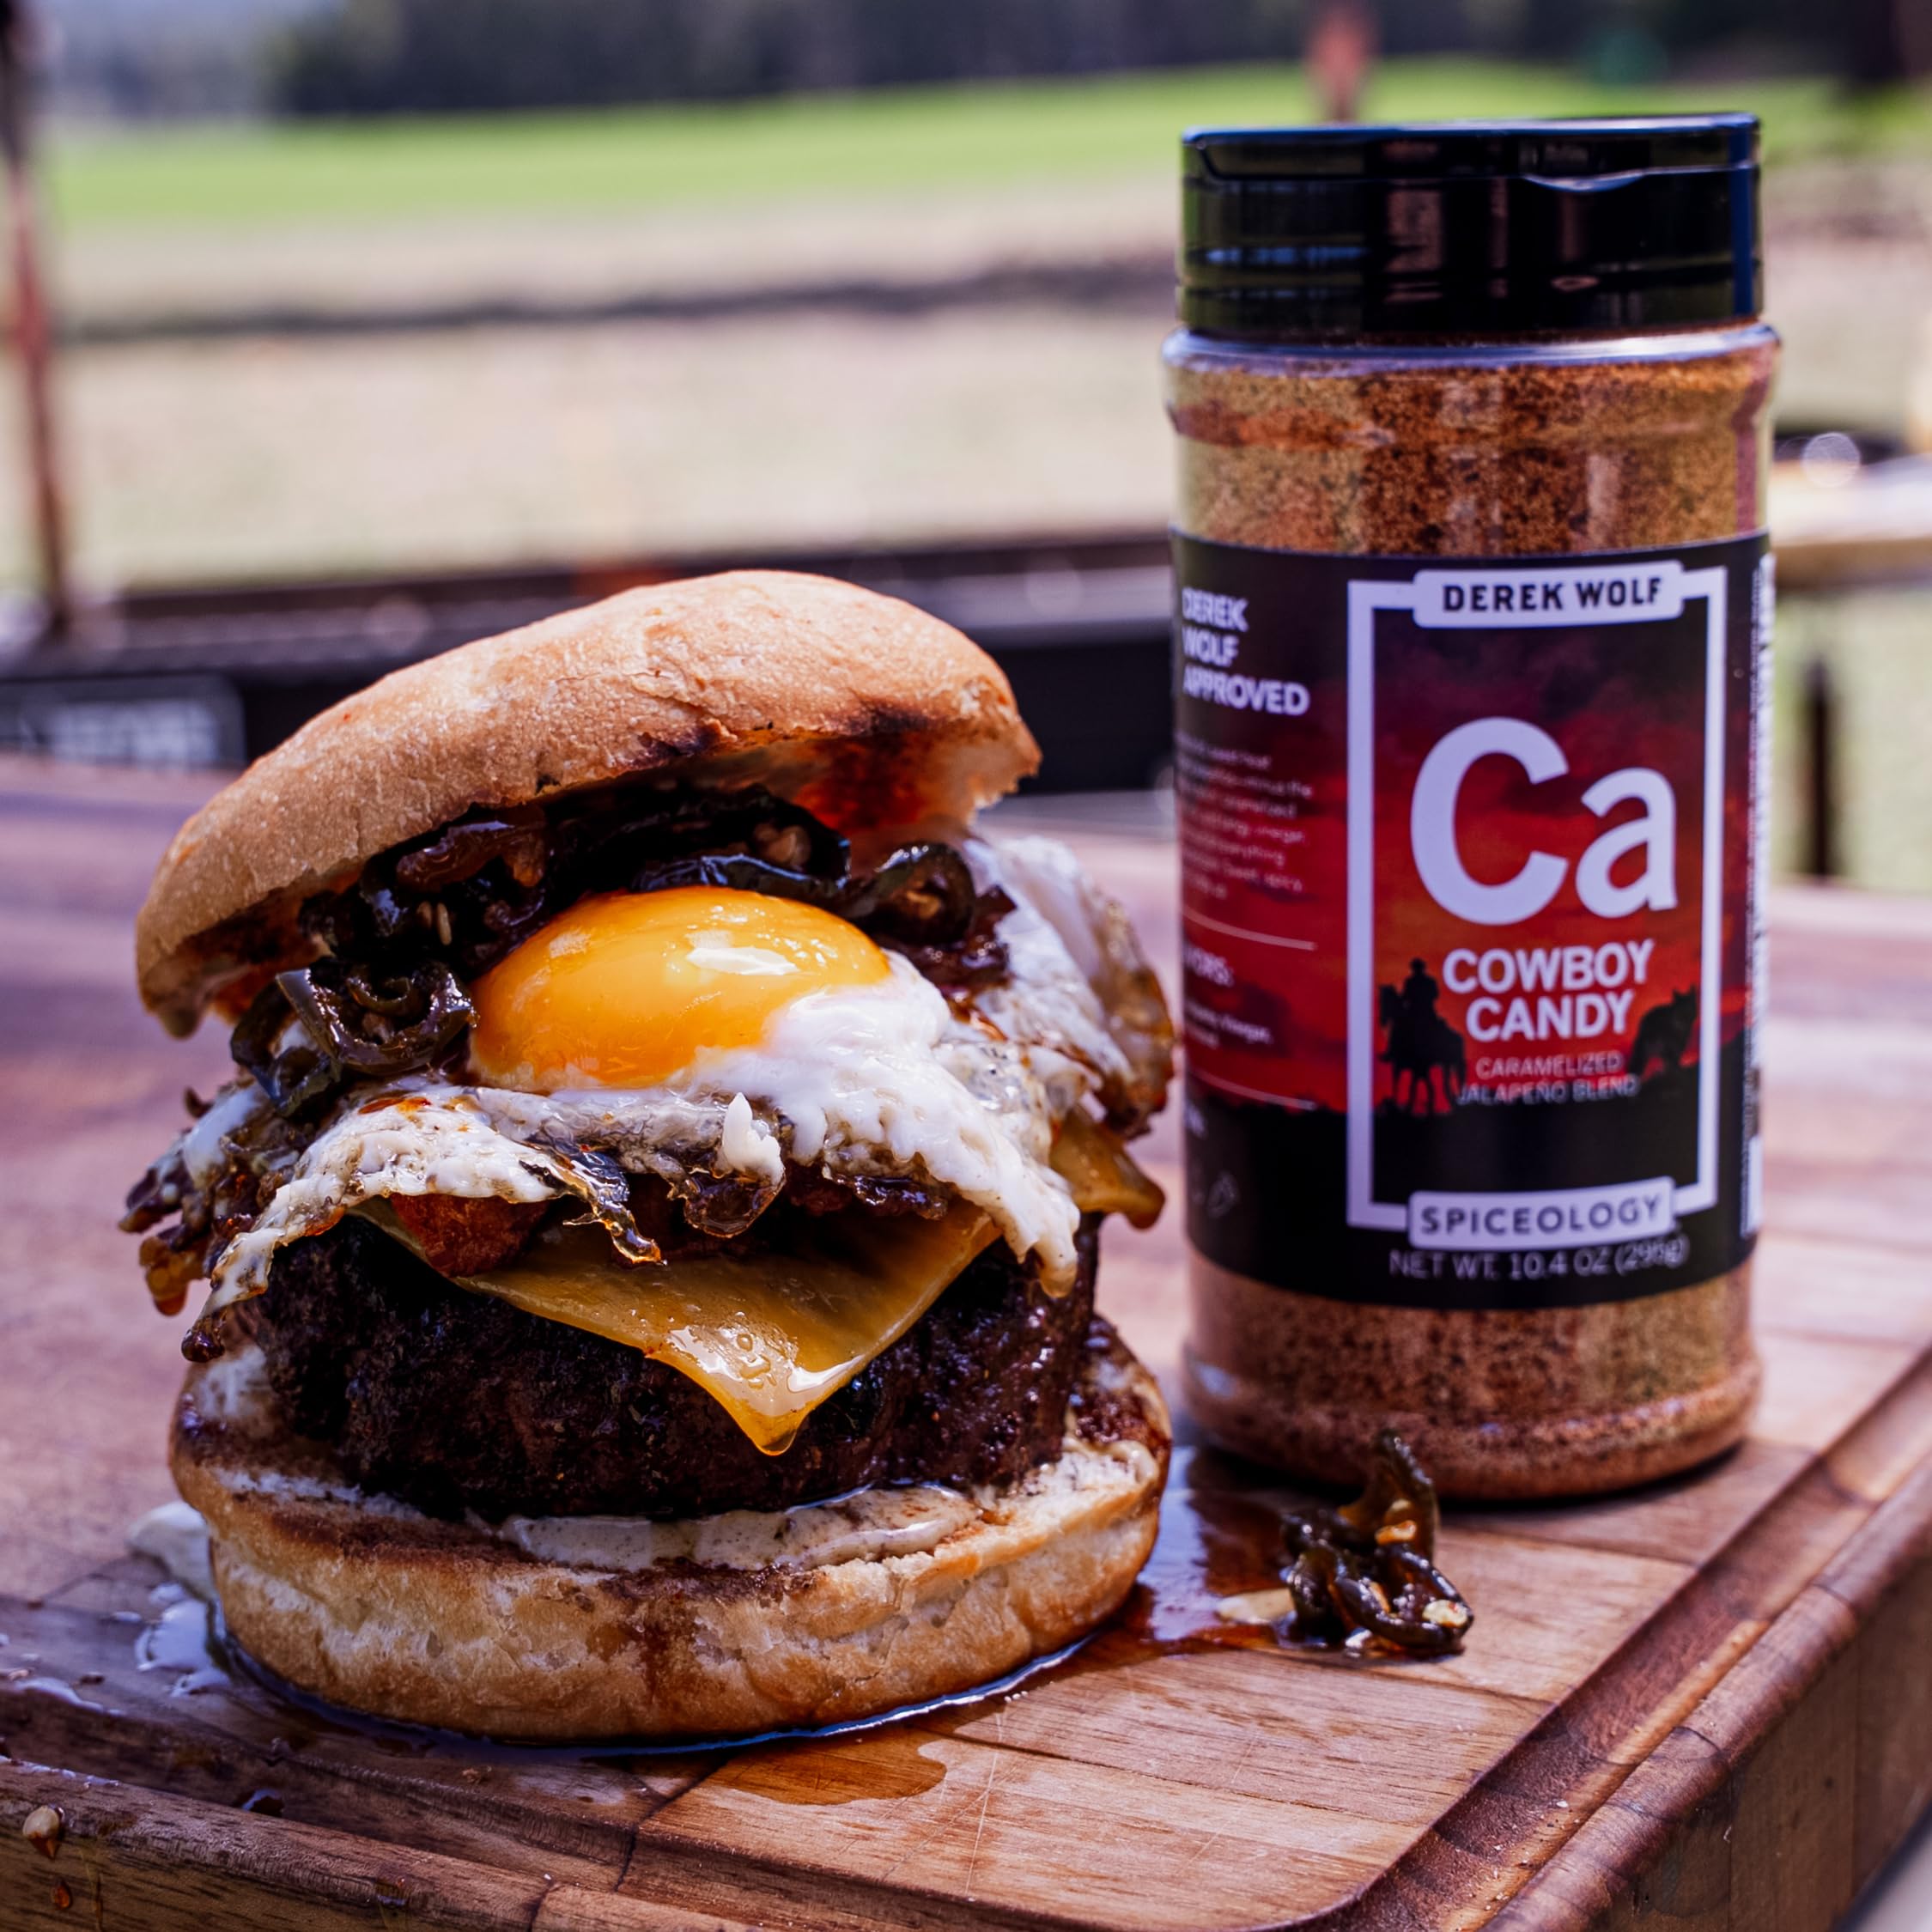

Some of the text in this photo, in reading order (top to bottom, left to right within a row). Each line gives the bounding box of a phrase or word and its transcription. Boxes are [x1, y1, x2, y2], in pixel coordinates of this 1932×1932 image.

[1182, 587, 1249, 633] DEREK
[1442, 577, 1662, 612] DEREK WOLF
[1182, 624, 1239, 667] WOLF
[1182, 664, 1311, 715] APPROVED
[1410, 717, 1677, 926] Ca
[1443, 938, 1654, 993] COWBOY
[1466, 988, 1634, 1042] CANDY
[1475, 1049, 1625, 1079] CARAMELIZED
[1572, 1073, 1640, 1103] BLEND
[1420, 1194, 1662, 1236] SPICEOLOGY
[1388, 1249, 1446, 1279] NET
[1510, 1250, 1568, 1279] 10.4
[1573, 1247, 1612, 1277] OZ
